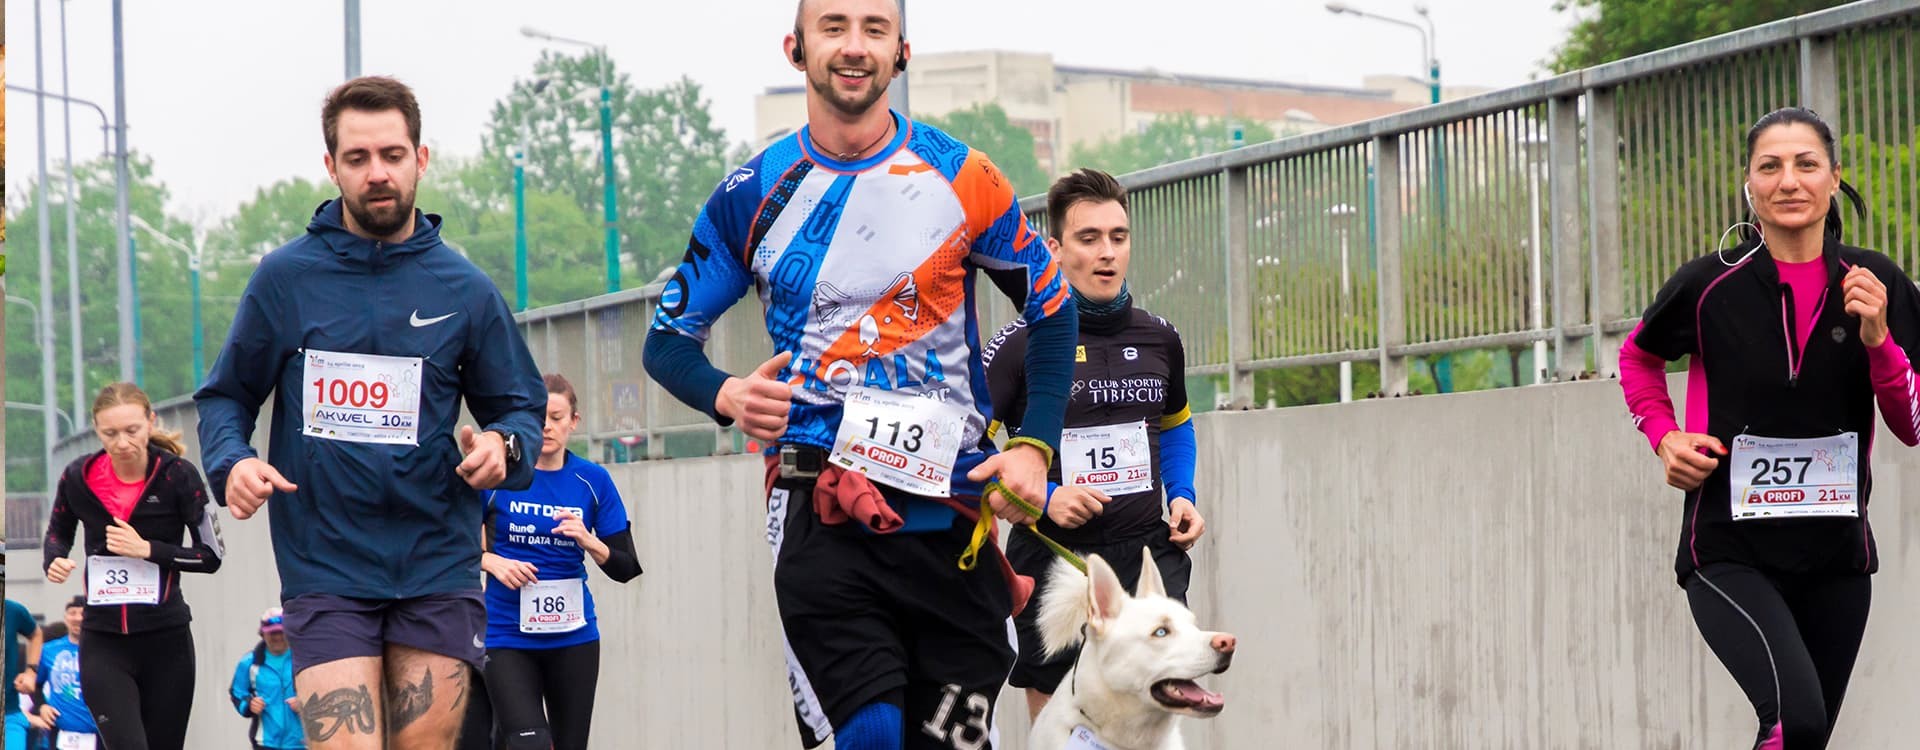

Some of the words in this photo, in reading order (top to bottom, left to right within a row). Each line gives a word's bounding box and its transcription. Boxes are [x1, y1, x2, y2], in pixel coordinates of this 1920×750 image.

[800, 349, 945, 392] KOALA
[1088, 379, 1119, 389] CLUB
[313, 377, 389, 409] 1009
[1089, 388, 1163, 403] TIBISCUS
[316, 410, 373, 424] AKWEL
[866, 416, 924, 453] 113
[870, 448, 906, 469] PROFI
[1085, 446, 1117, 469] 15
[1089, 473, 1117, 482] PROFI
[1750, 456, 1813, 485] 257
[1766, 490, 1802, 502] PROFI
[510, 500, 541, 516] NTT
[509, 534, 526, 544] NTT
[528, 535, 551, 546] DATA
[105, 569, 129, 585] 33
[532, 595, 565, 613] 186
[922, 683, 990, 750] 13
